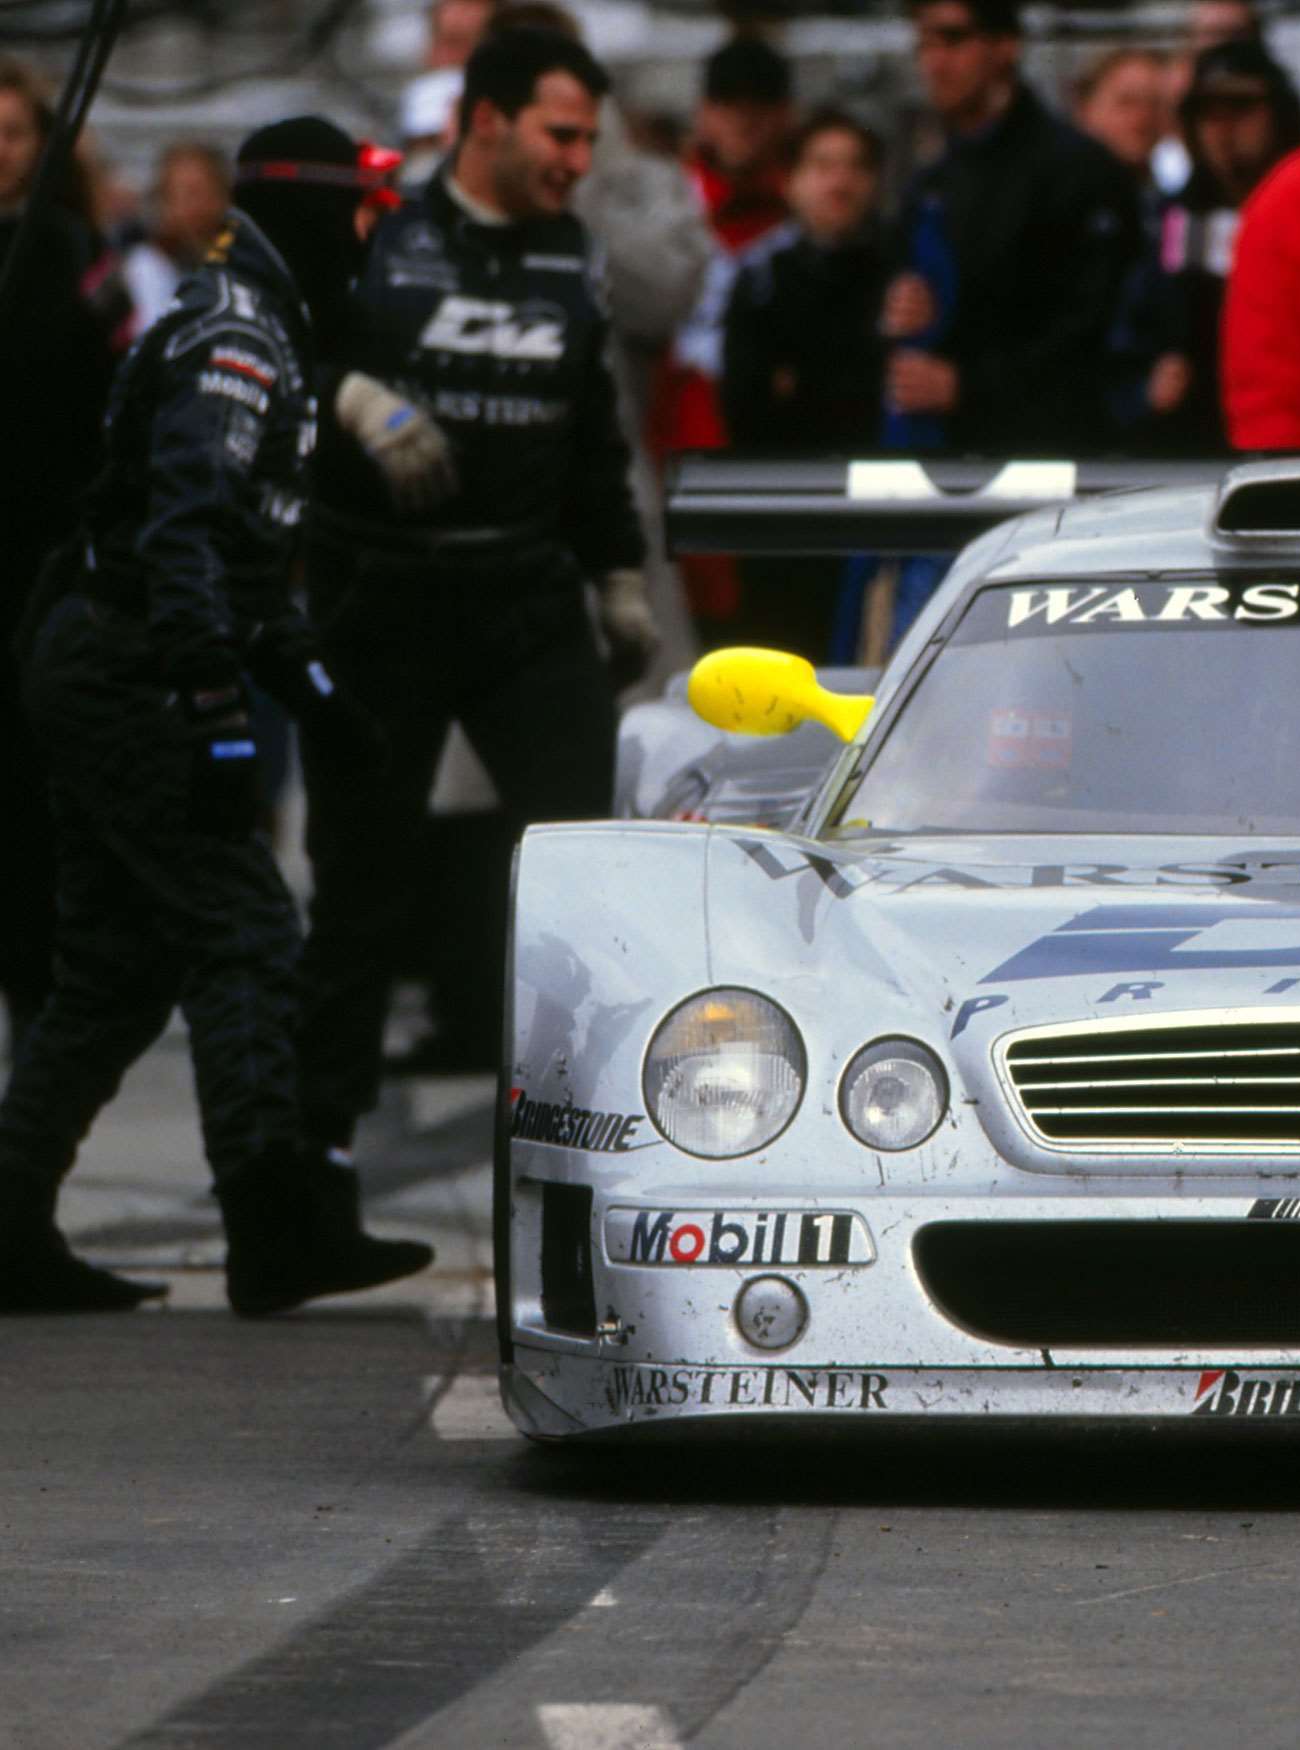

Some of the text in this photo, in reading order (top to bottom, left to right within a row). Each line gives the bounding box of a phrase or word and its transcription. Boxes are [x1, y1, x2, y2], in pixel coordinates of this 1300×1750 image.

[510, 1089, 646, 1151] BRIDGESTONE
[629, 1211, 788, 1264] Mobil
[609, 1366, 890, 1410] WARSTEINER
